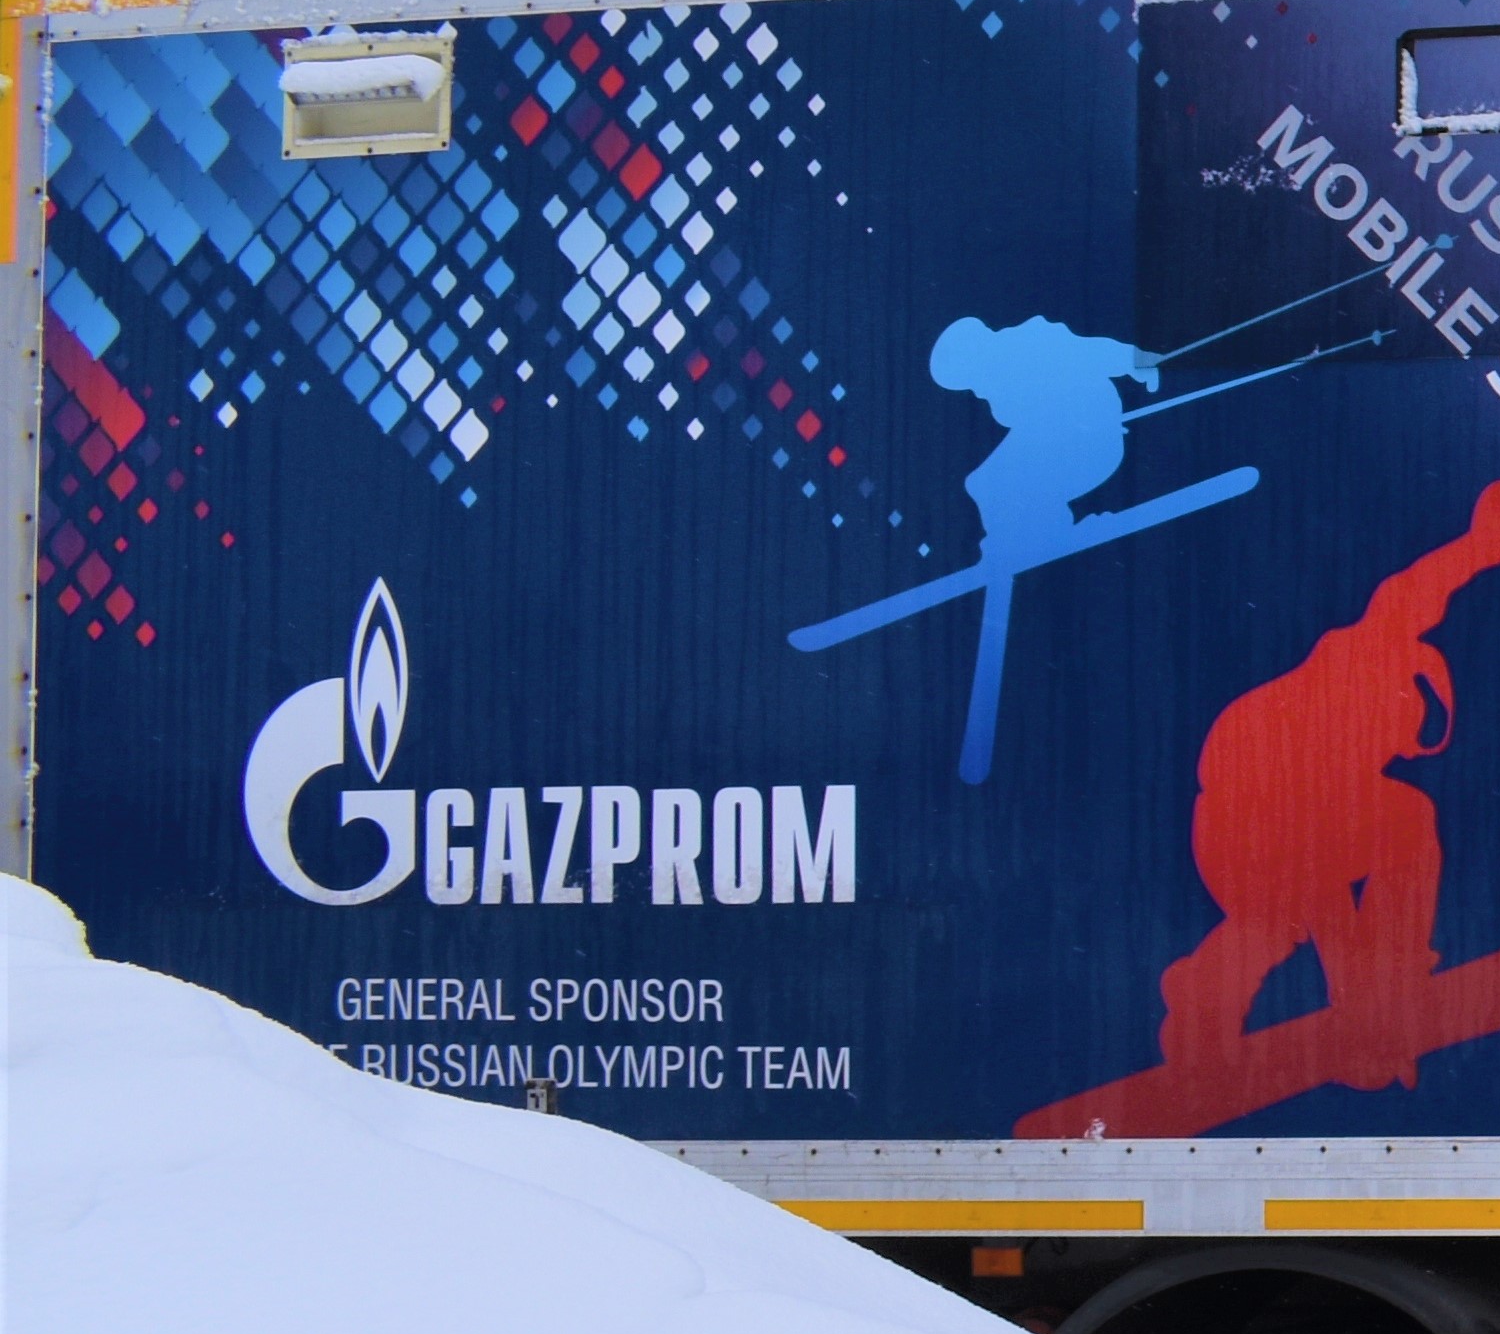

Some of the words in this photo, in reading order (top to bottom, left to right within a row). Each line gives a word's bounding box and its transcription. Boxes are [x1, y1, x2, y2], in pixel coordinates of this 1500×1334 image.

[1256, 104, 1499, 359] MOBILE
[425, 783, 856, 906] GAZPROM
[336, 977, 516, 1022] GENERAL
[528, 978, 724, 1022] SPONSOR
[363, 1043, 533, 1088] RUSSIAN
[547, 1043, 725, 1090] OLYMPIC
[737, 1045, 851, 1091] TEAM
